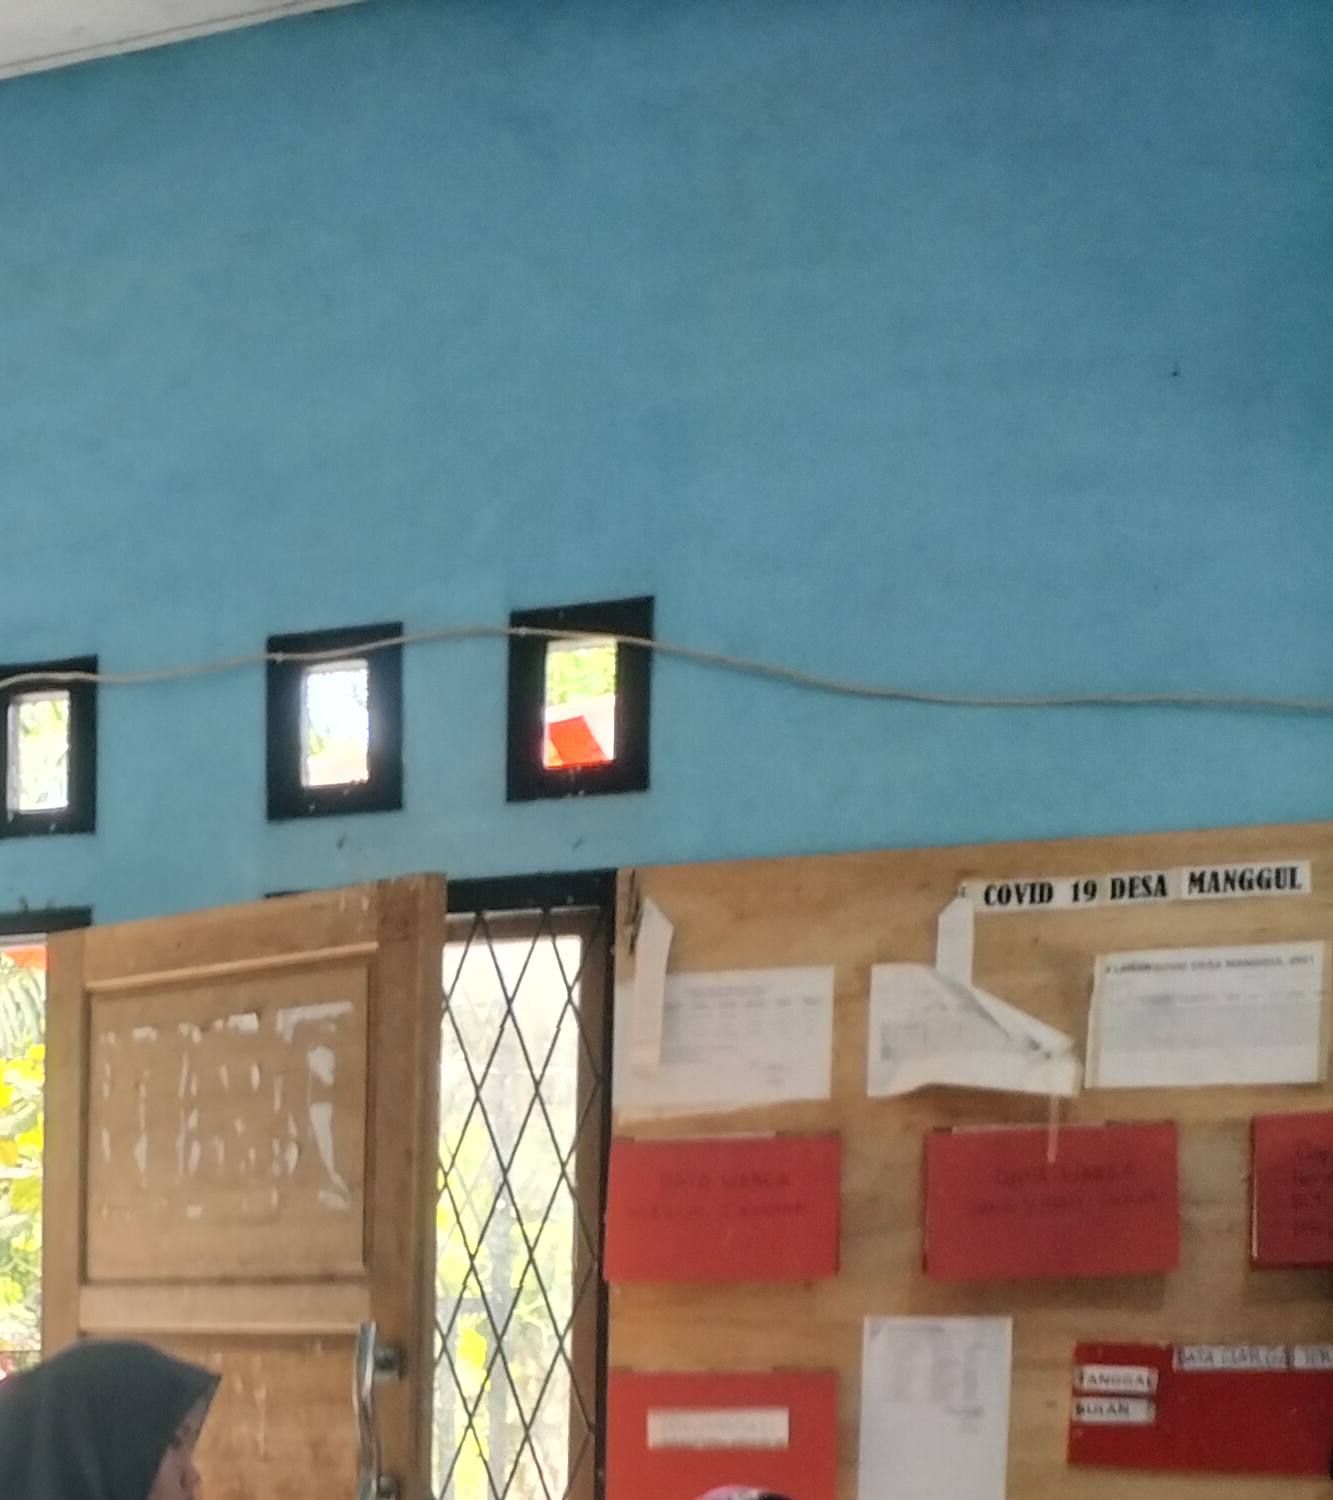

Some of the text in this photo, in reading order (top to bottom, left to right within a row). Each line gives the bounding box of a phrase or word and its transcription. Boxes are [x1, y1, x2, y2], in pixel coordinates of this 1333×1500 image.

[983, 880, 1054, 907] COVID
[1070, 878, 1098, 903] 19
[1109, 874, 1169, 900] DESA
[1187, 865, 1304, 895] MANGGUL
